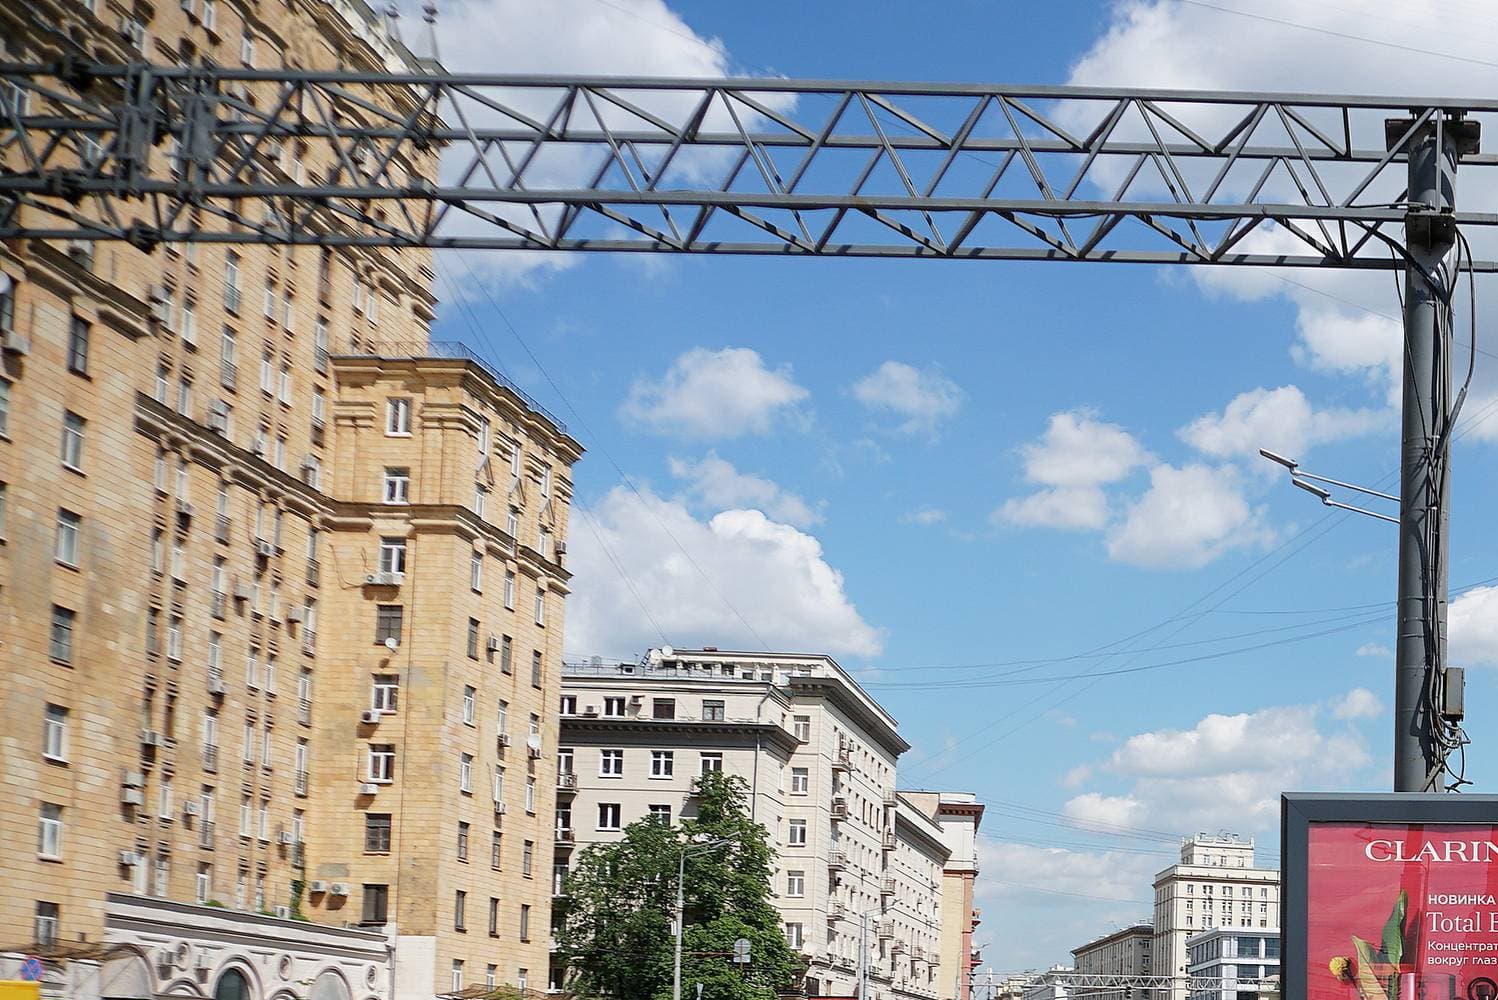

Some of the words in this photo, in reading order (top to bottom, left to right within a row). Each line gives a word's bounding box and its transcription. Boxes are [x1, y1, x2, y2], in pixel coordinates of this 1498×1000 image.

[1428, 894, 1496, 905] НОВИНКА
[1426, 911, 1482, 933] Total
[1427, 941, 1498, 952] Концентрат
[1427, 956, 1468, 966] вокруг
[1472, 957, 1497, 965] глаз
